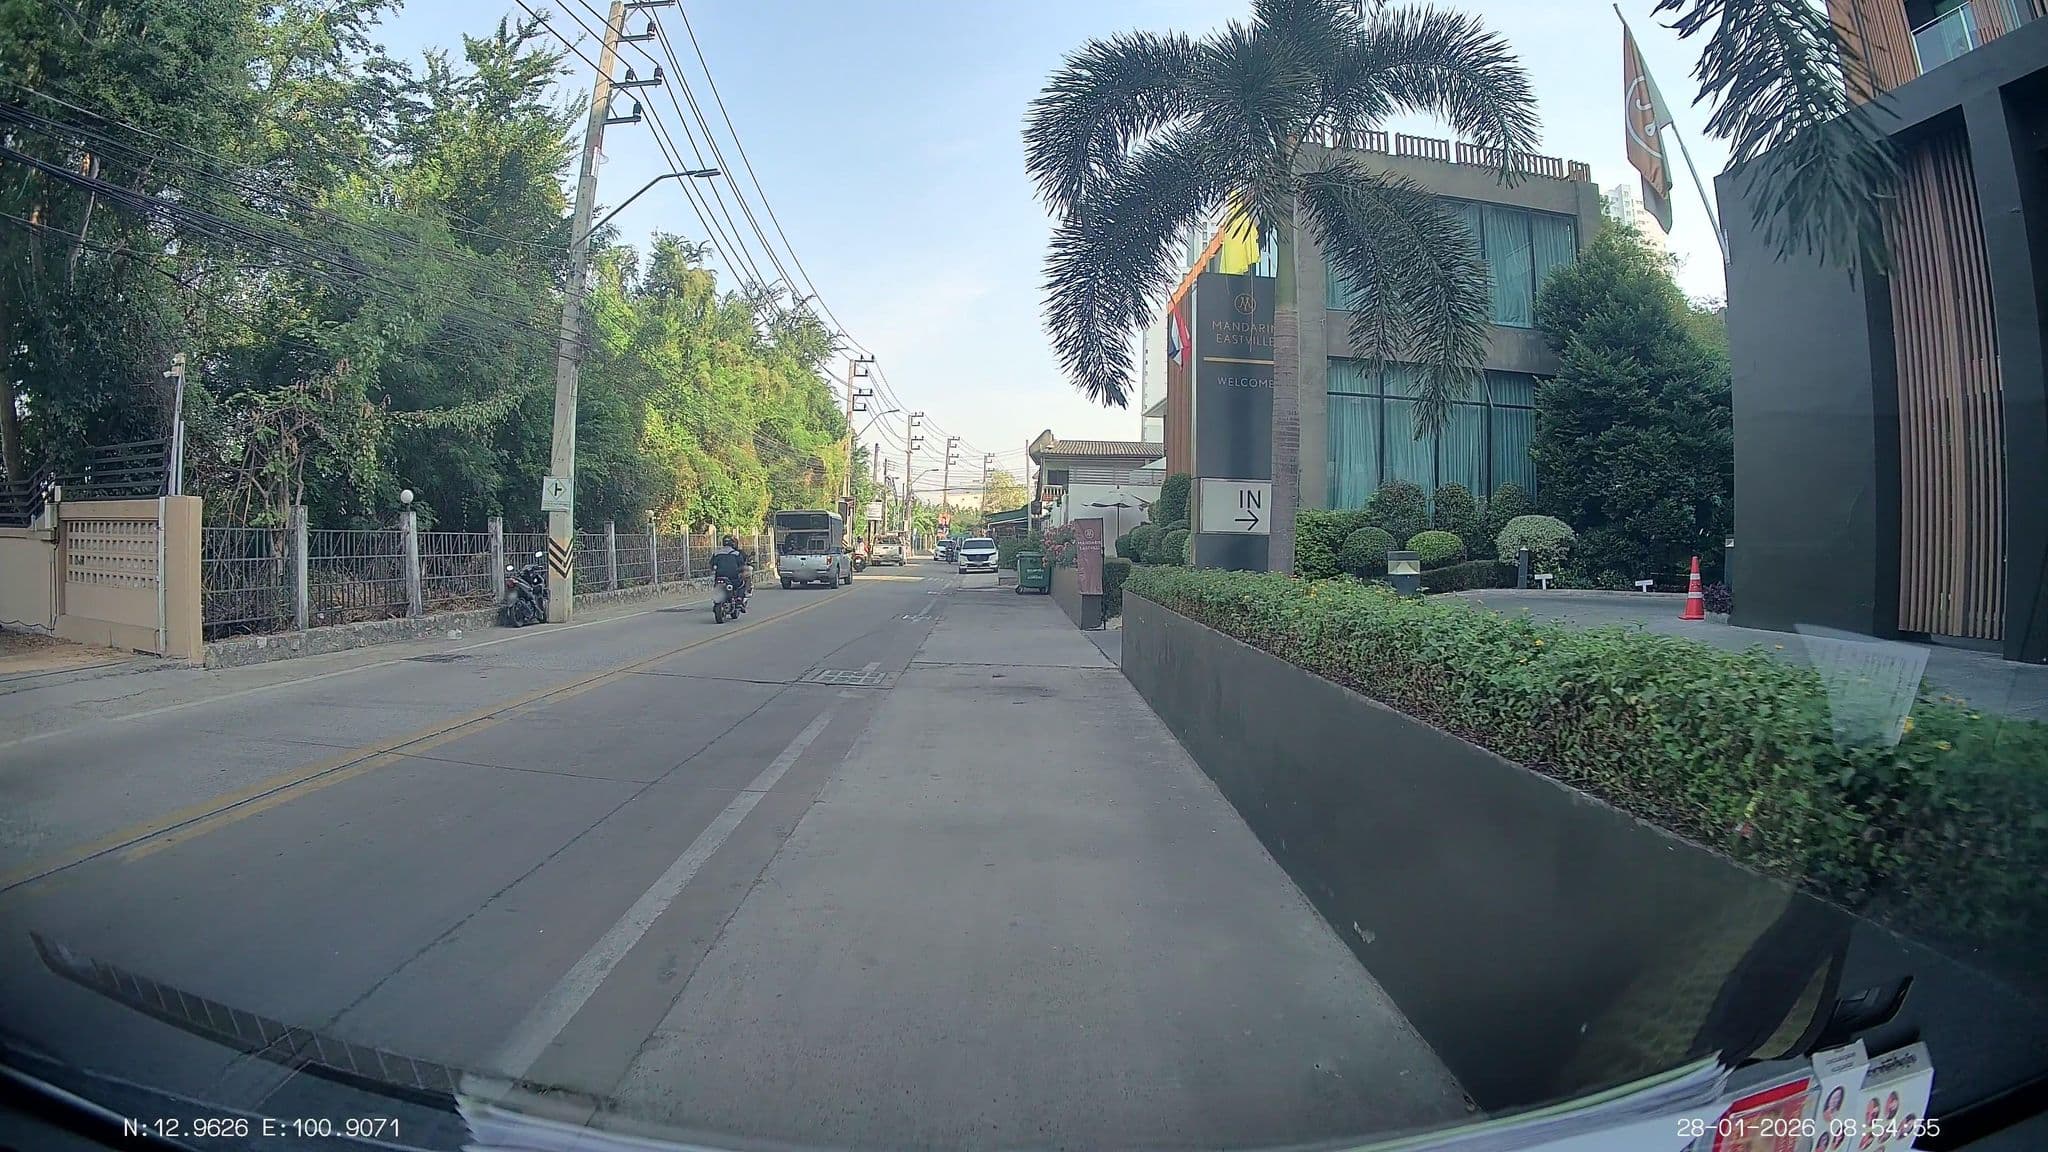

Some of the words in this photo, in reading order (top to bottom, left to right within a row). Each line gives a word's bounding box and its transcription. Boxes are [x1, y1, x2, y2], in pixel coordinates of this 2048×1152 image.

[1216, 333, 1274, 346] EASTVILLE
[1217, 377, 1274, 388] WELCOME
[1240, 490, 1260, 509] IN
